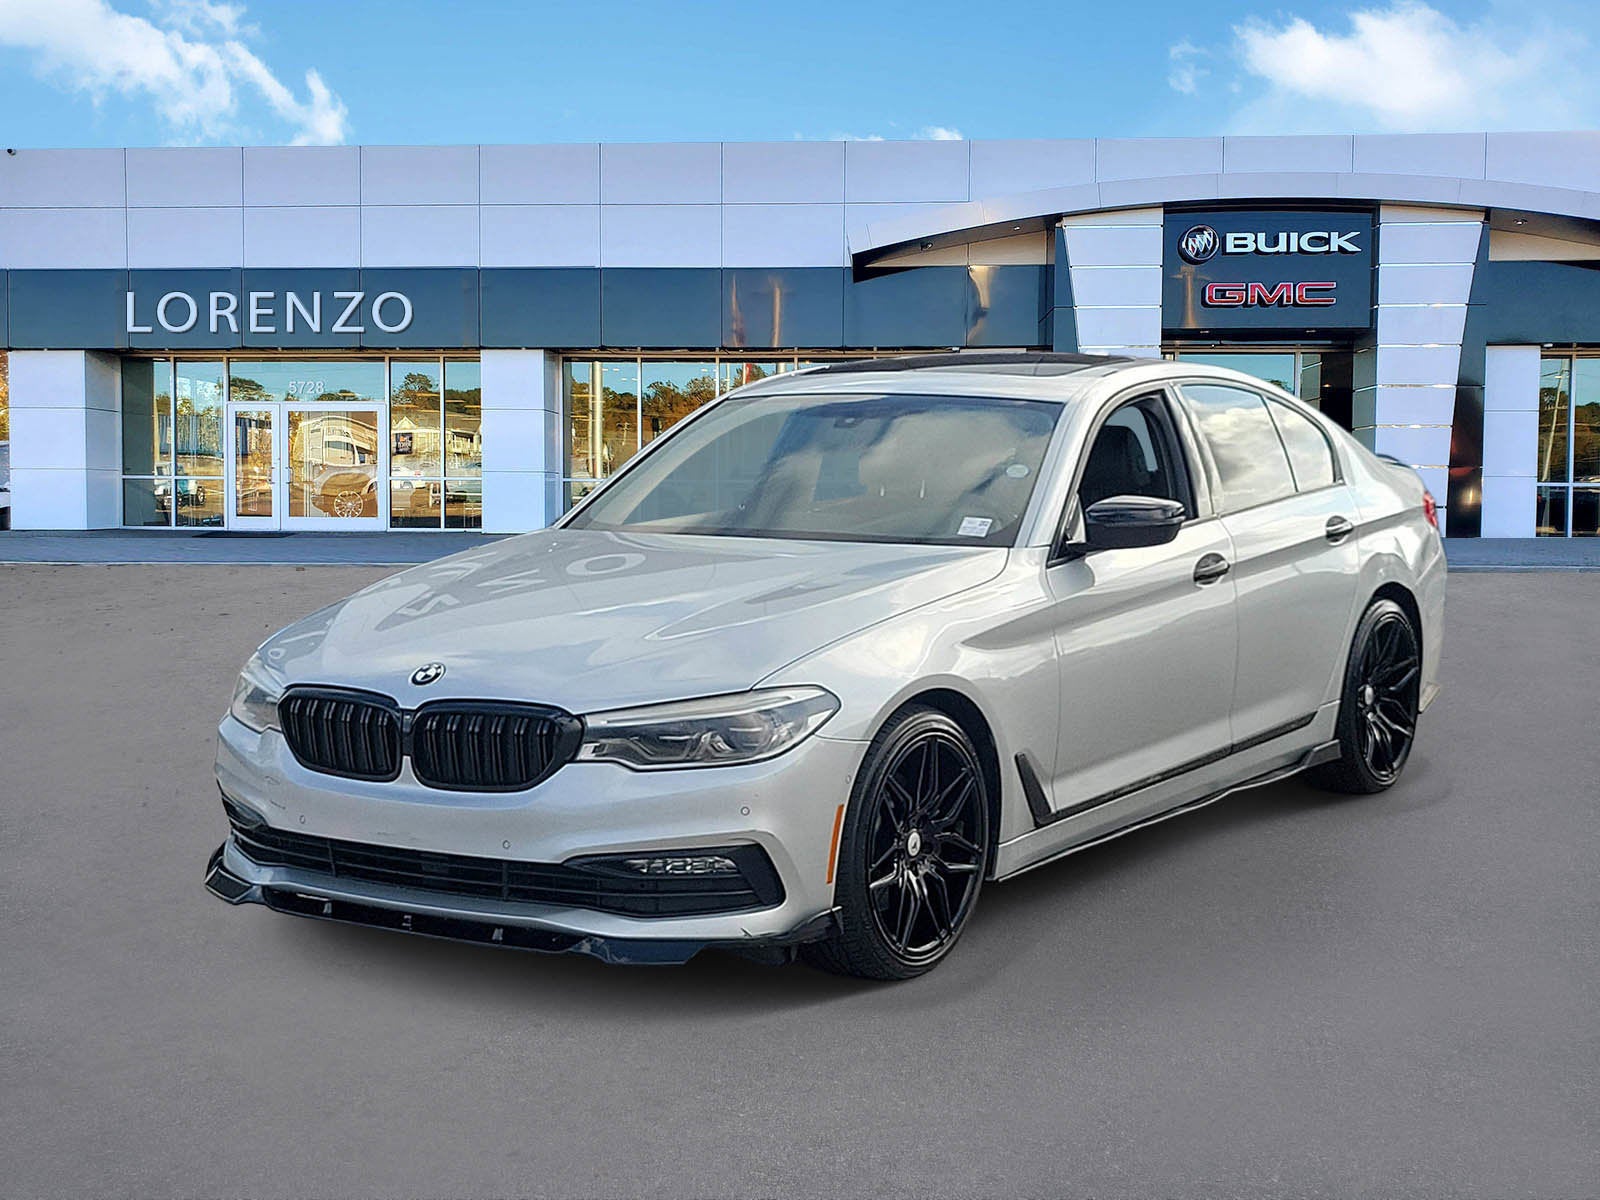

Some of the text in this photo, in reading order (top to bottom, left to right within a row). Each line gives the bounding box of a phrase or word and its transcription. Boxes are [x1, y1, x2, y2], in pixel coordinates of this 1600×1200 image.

[1225, 231, 1362, 253] BUICK
[1205, 282, 1337, 306] GMC
[126, 291, 413, 333] LORENZO
[288, 381, 325, 394] 5728
